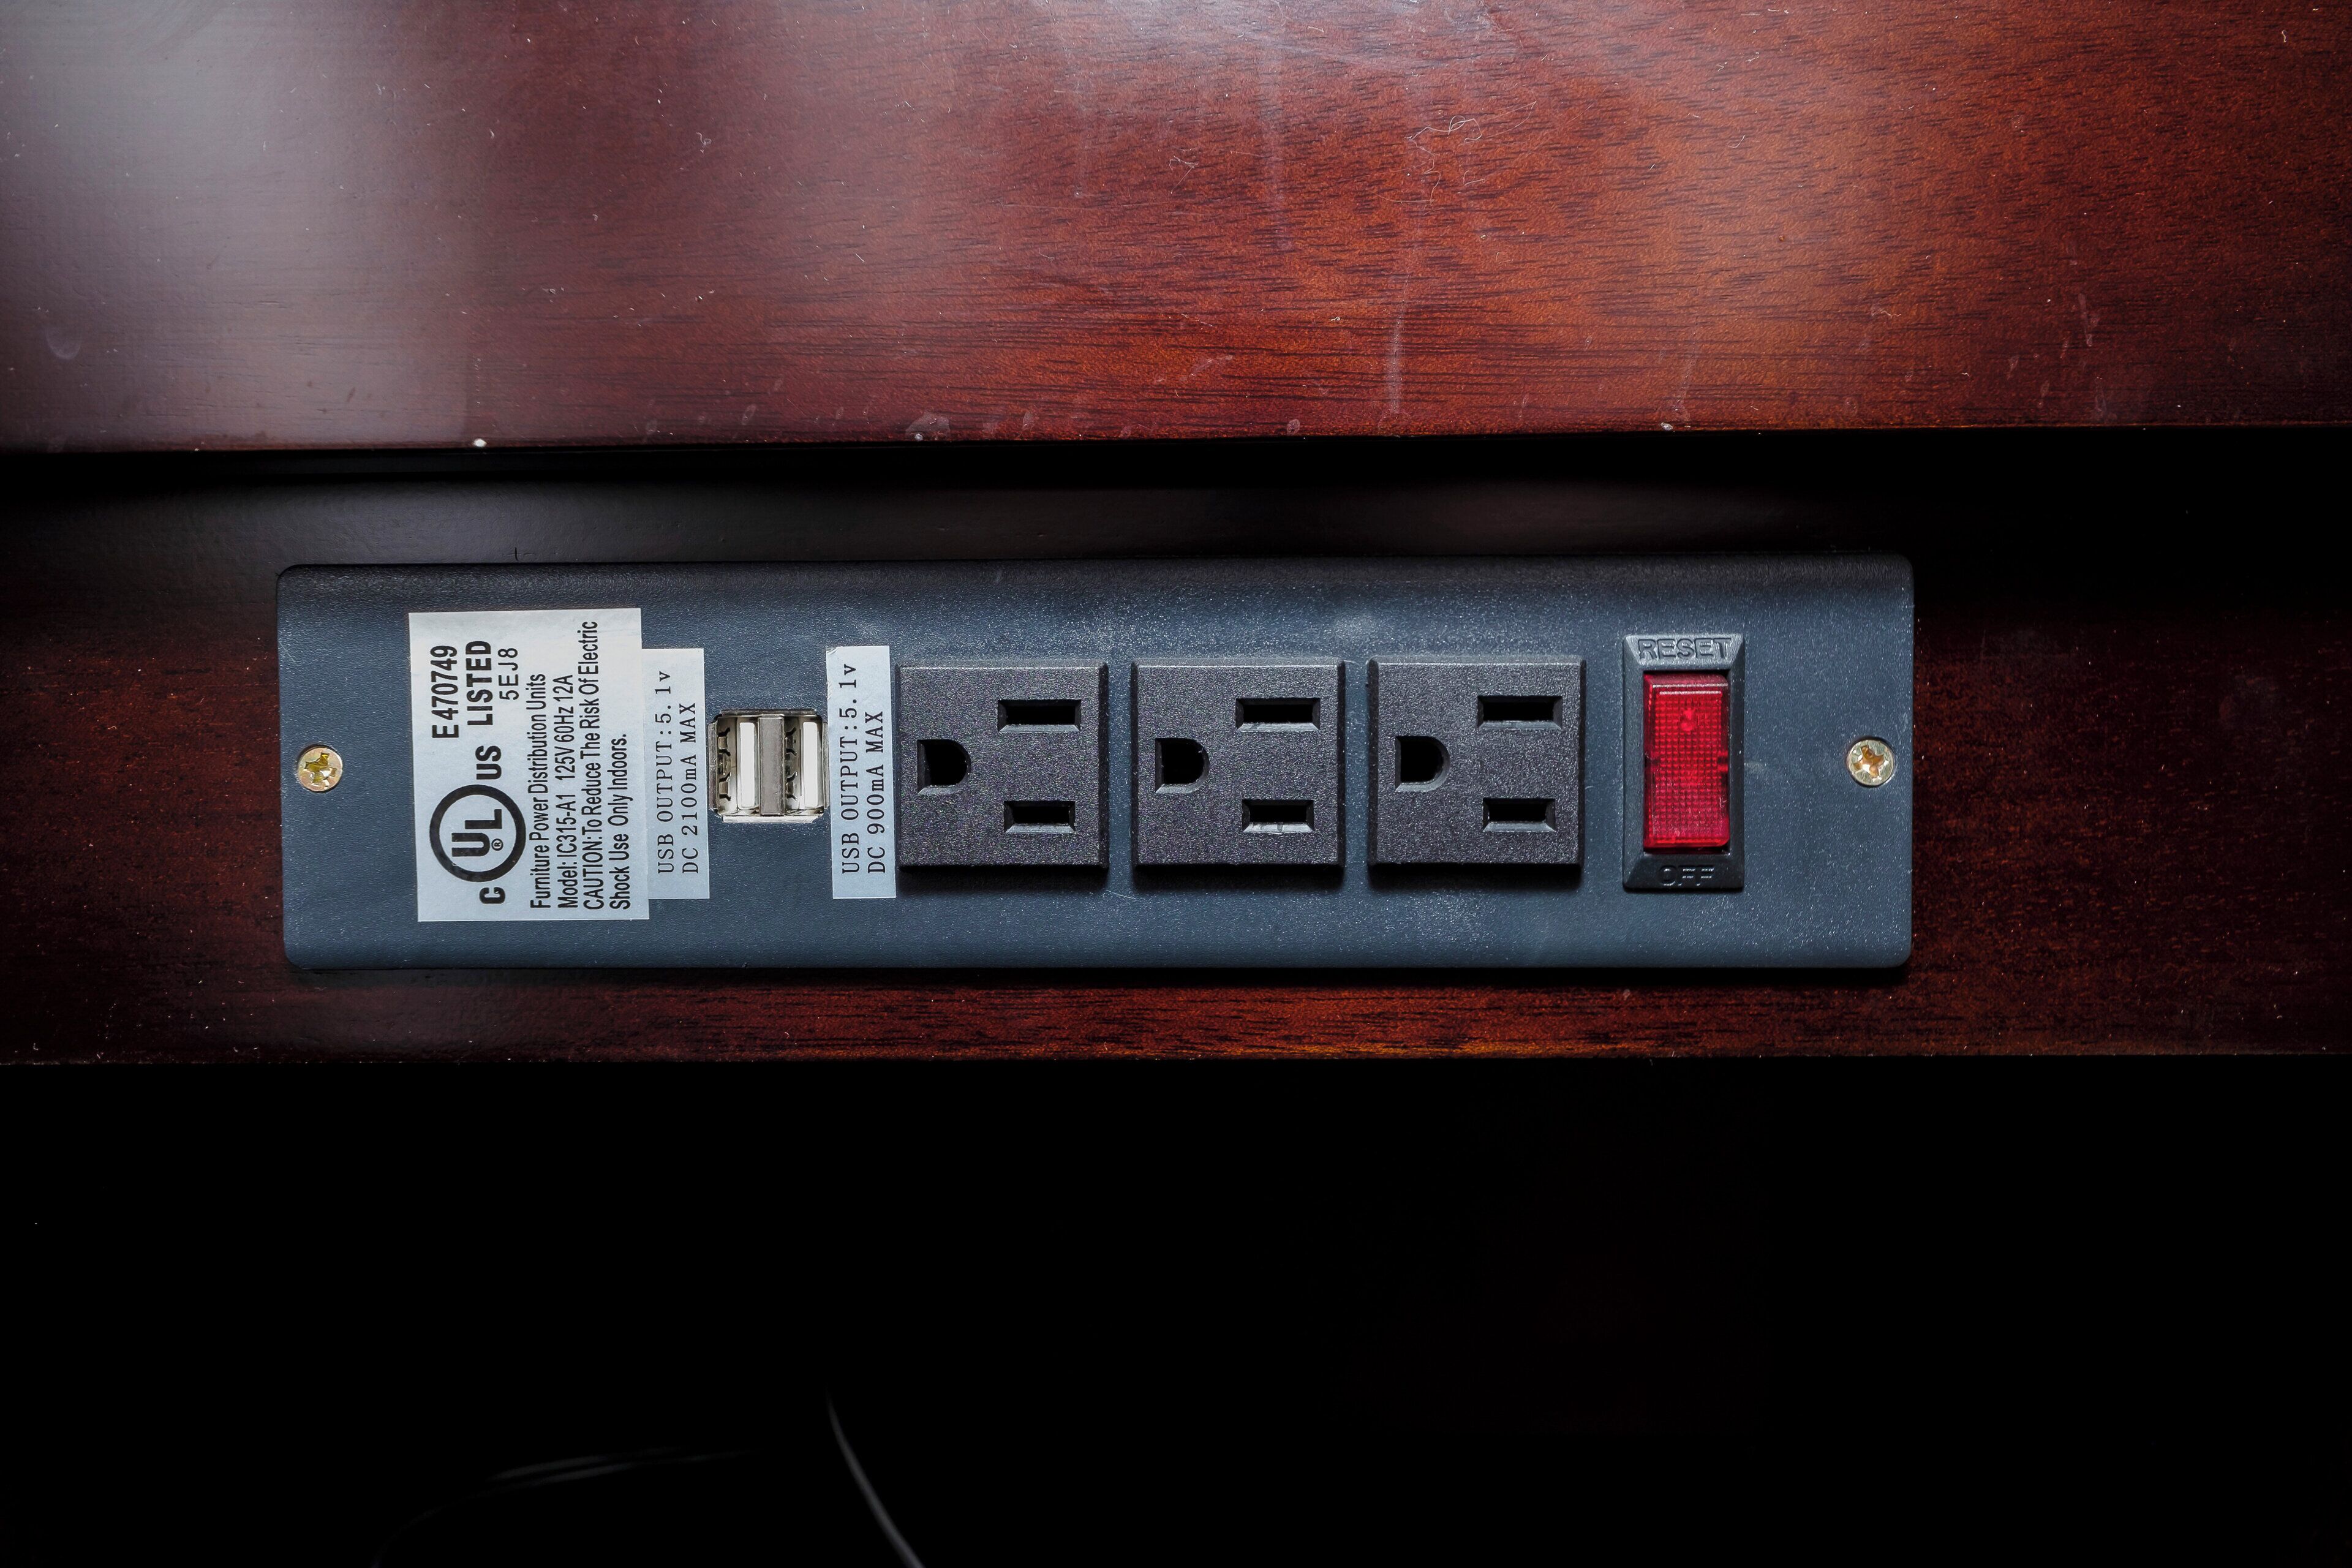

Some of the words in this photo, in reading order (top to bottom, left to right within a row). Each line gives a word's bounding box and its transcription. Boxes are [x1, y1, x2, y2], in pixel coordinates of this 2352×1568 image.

[577, 621, 599, 675] Electric
[1638, 638, 1732, 660] RESET
[465, 640, 493, 726] LISTED
[497, 647, 519, 701] 5EJ8
[525, 674, 547, 710] Units
[552, 674, 573, 702] 12A
[578, 677, 599, 695] Of
[553, 706, 575, 743] 60Hz
[578, 698, 600, 729] Risk
[679, 703, 696, 744] MAX
[864, 711, 884, 753] MAX
[475, 745, 502, 780] US
[527, 714, 548, 794] Distribution
[554, 746, 576, 781] 125V
[579, 733, 601, 760] The
[606, 734, 628, 790] Indoors.
[581, 763, 602, 815] Reduce
[680, 754, 698, 836] 2100mA
[865, 764, 885, 835] 900mA
[529, 796, 549, 841] Power
[556, 794, 578, 858] IC315-A1
[607, 794, 633, 826] Only
[608, 834, 630, 861] Use
[657, 834, 674, 874] USB
[681, 848, 699, 874] DC
[841, 832, 860, 874] USB
[867, 846, 886, 874] DC
[529, 845, 551, 908] Furniture
[557, 861, 579, 908] Model:
[608, 865, 631, 910] Shock
[1659, 865, 1714, 886] OFF
